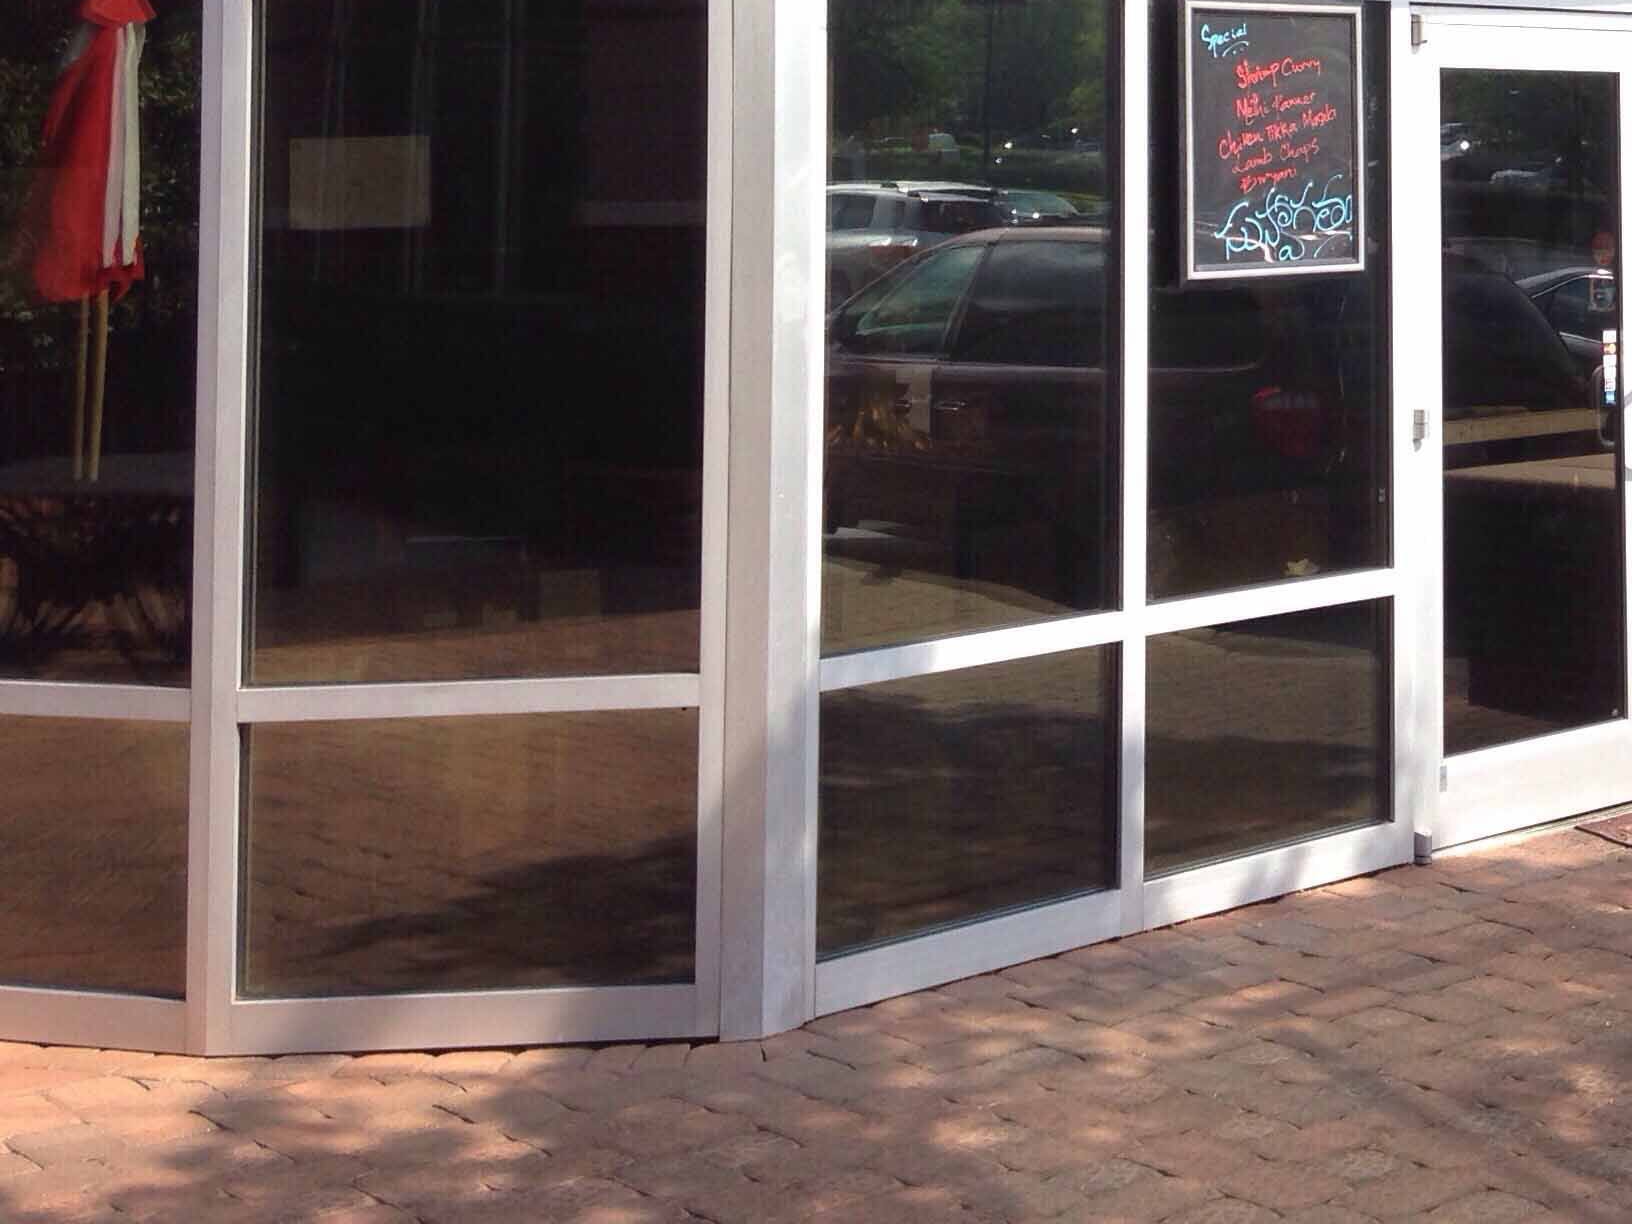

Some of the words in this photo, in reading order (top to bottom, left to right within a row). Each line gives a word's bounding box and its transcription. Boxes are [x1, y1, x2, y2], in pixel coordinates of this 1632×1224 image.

[1200, 23, 1247, 58] Special
[1236, 59, 1280, 88] Shrimp
[1281, 56, 1320, 76] Curry
[1232, 147, 1272, 174] Lamb
